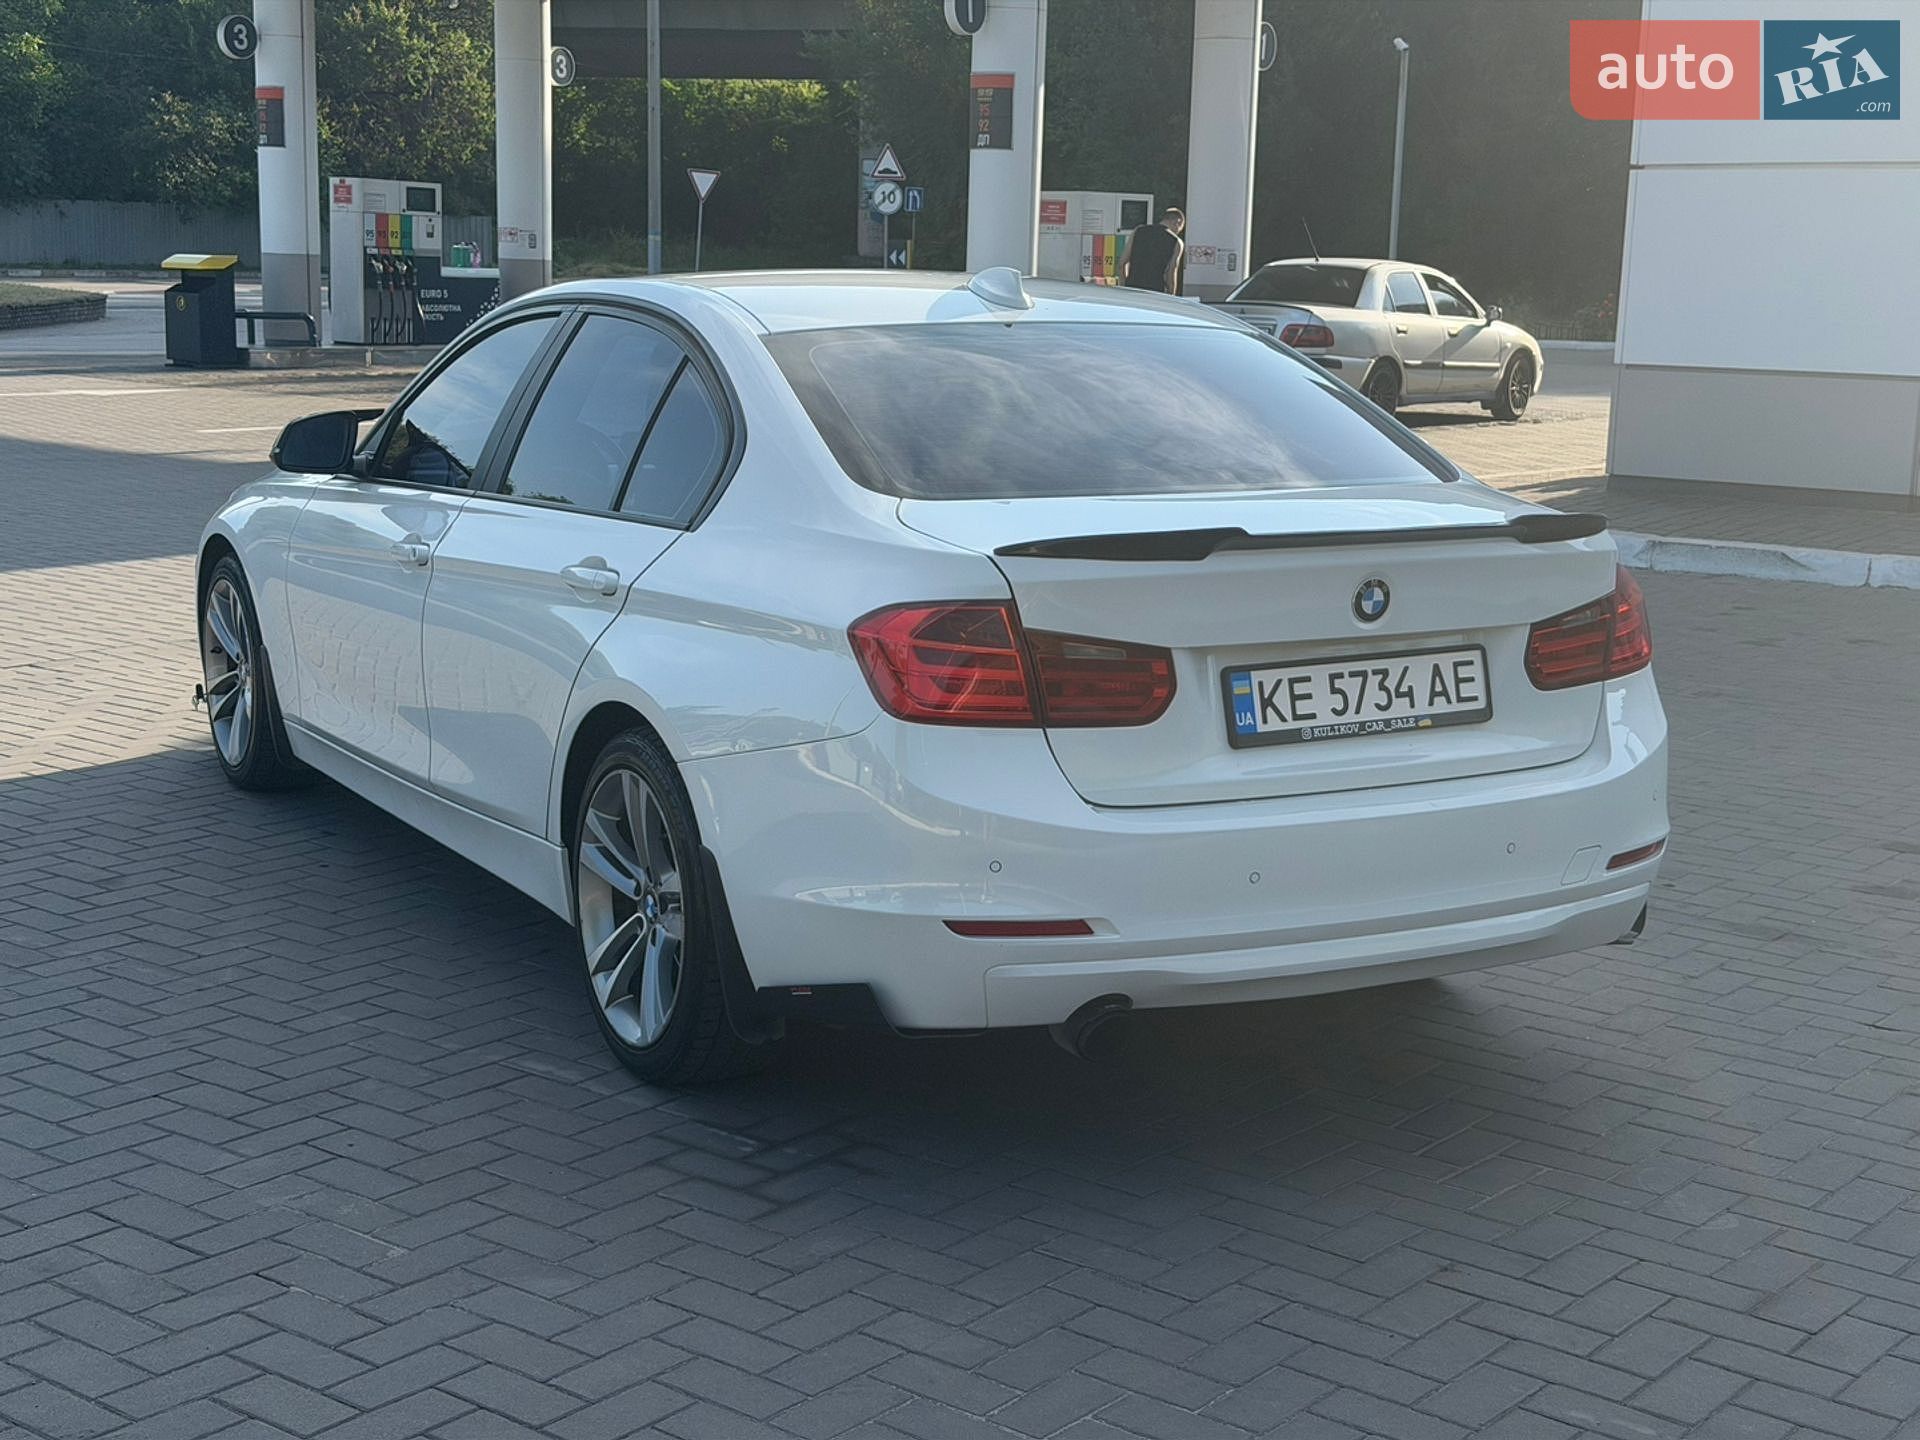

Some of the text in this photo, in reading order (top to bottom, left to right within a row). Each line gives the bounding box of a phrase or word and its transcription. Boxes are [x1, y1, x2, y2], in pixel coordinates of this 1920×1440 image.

[233, 23, 248, 50] 3
[555, 54, 567, 78] 3
[420, 288, 449, 299] EURO 5
[1257, 660, 1479, 725] KE 5734 AE
[1236, 711, 1255, 727] UA
